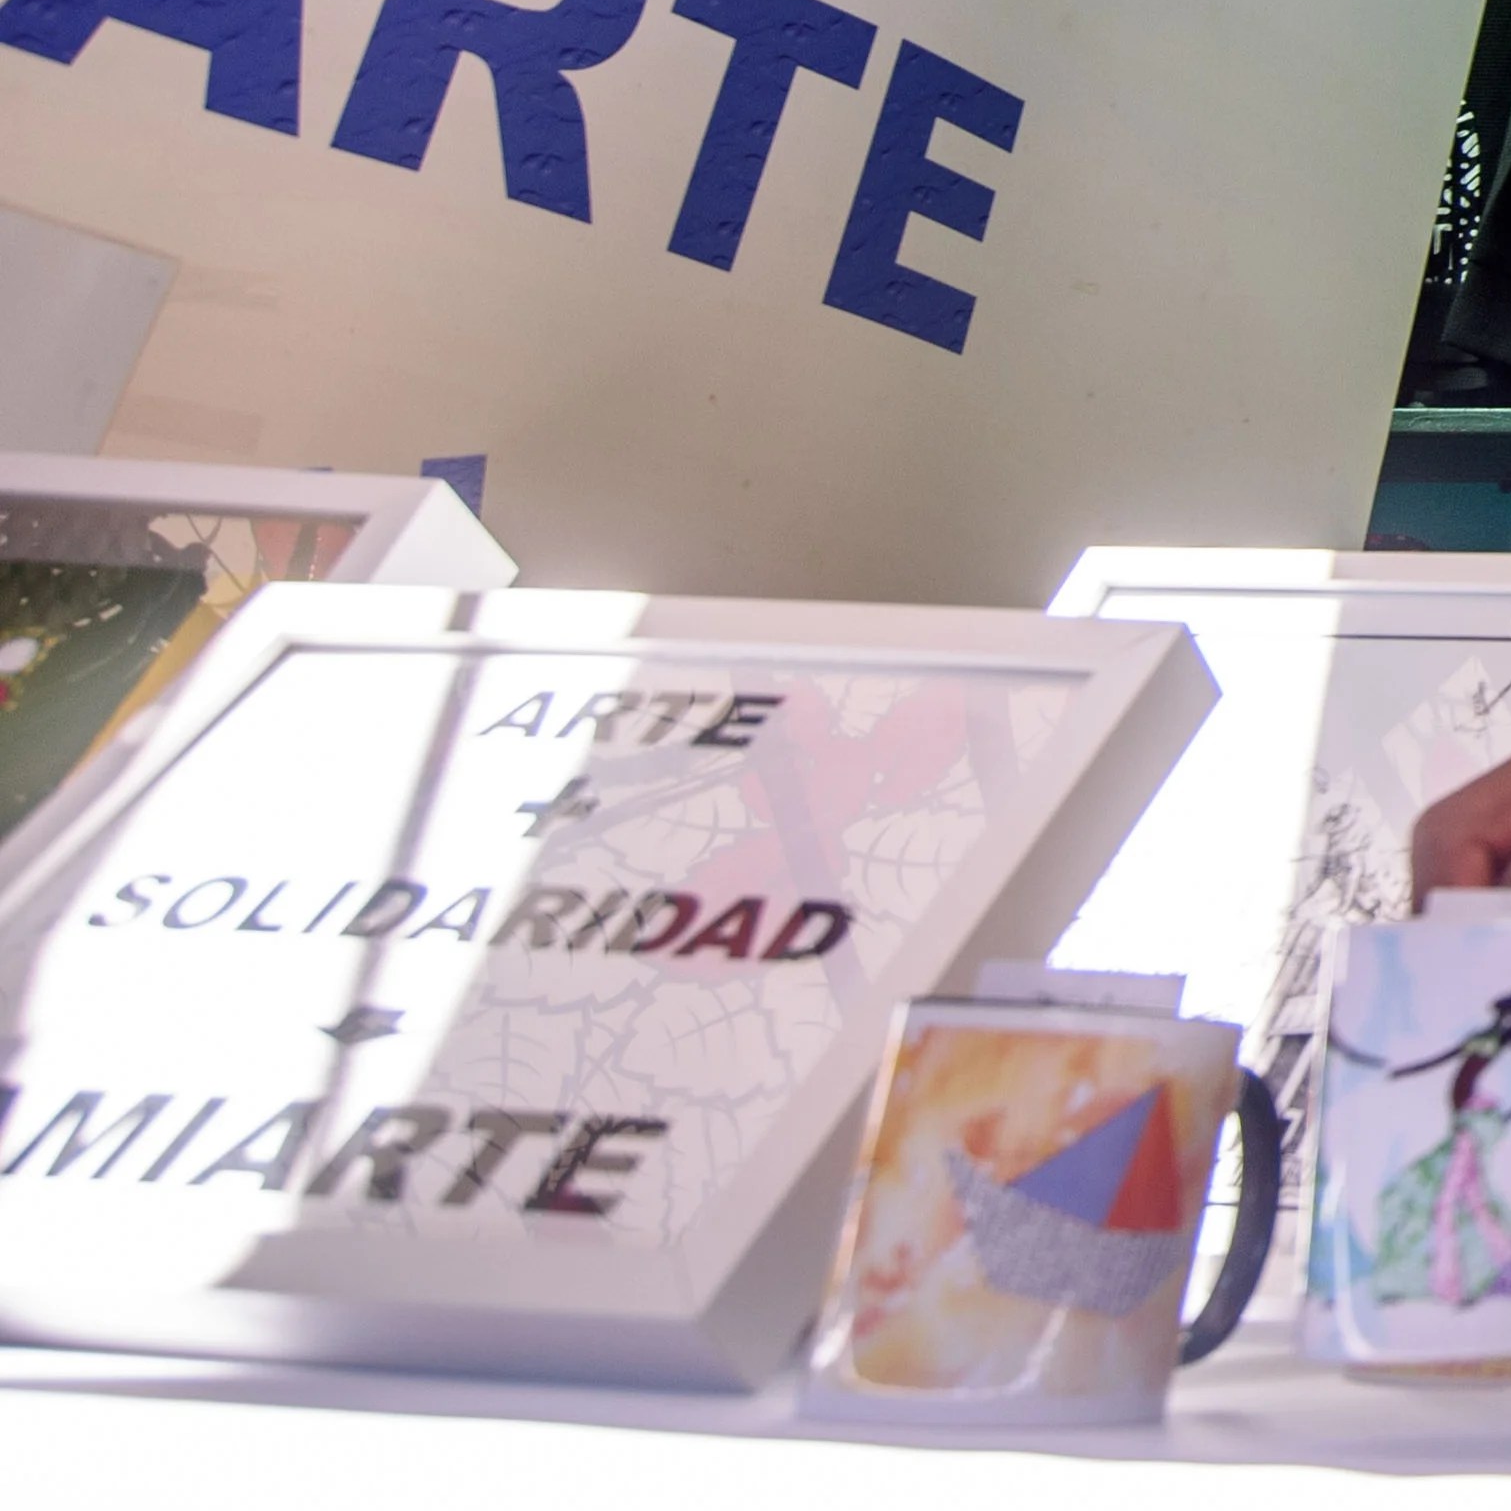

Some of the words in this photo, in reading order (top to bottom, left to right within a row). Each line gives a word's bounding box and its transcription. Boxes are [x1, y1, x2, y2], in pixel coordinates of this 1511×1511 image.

[477, 691, 786, 749] ARTE
[88, 874, 857, 962] SOLIDARIDAD
[0, 1085, 669, 1216] MIARTE
